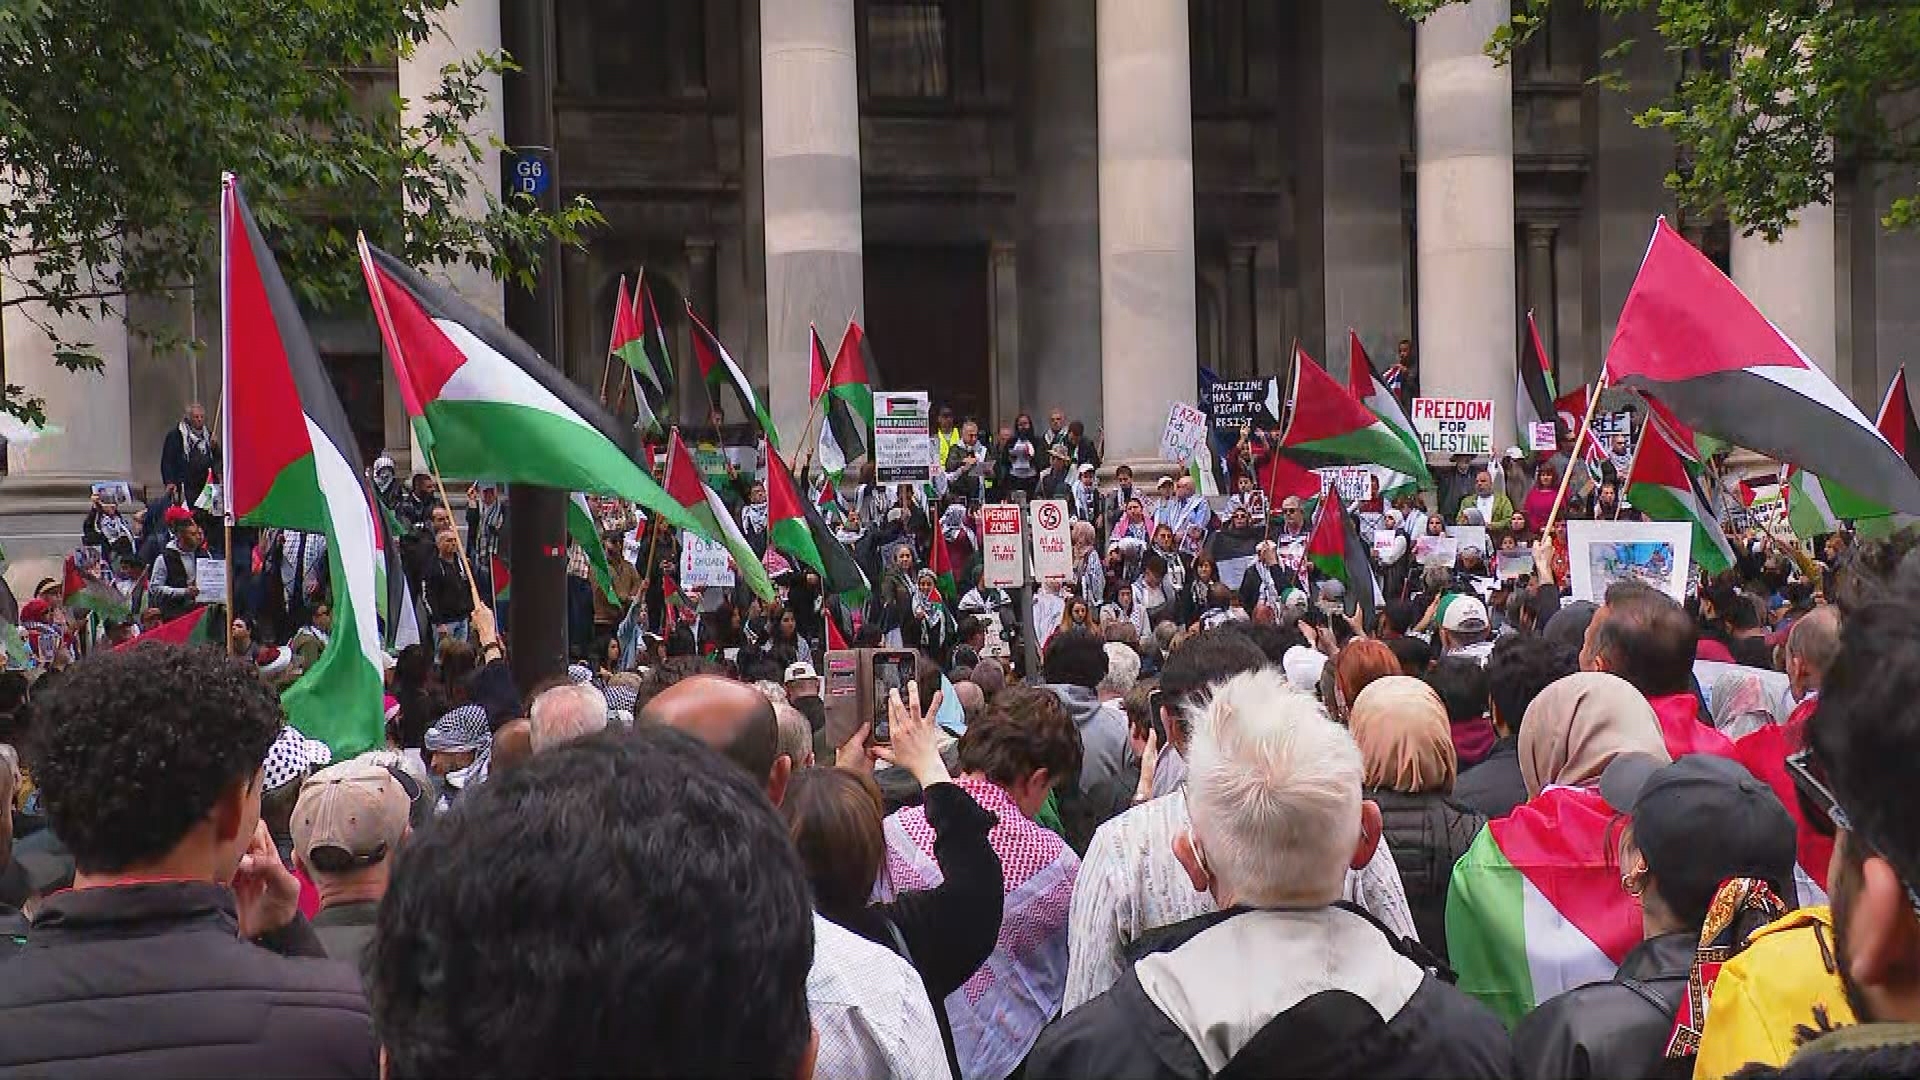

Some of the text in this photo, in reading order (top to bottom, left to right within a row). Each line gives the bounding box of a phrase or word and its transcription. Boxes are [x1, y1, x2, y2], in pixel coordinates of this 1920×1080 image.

[517, 161, 542, 177] G6
[523, 177, 536, 193] D
[1212, 380, 1263, 392] PALESTINE
[1212, 391, 1253, 403] HAS THE
[1213, 402, 1262, 414] RIGHT TO
[1414, 400, 1491, 420] FREEDOM
[1215, 417, 1253, 428] RESIST
[1439, 421, 1467, 432] FOR
[1589, 411, 1626, 432] REE
[1420, 433, 1489, 452] ALESTINE
[985, 509, 1018, 521] PERMIT
[990, 521, 1015, 533] ZONE
[1040, 537, 1065, 545] AT ALL
[992, 545, 1016, 553] AT ALL
[1042, 545, 1064, 553] TIMES
[994, 553, 1015, 561] TIMES
